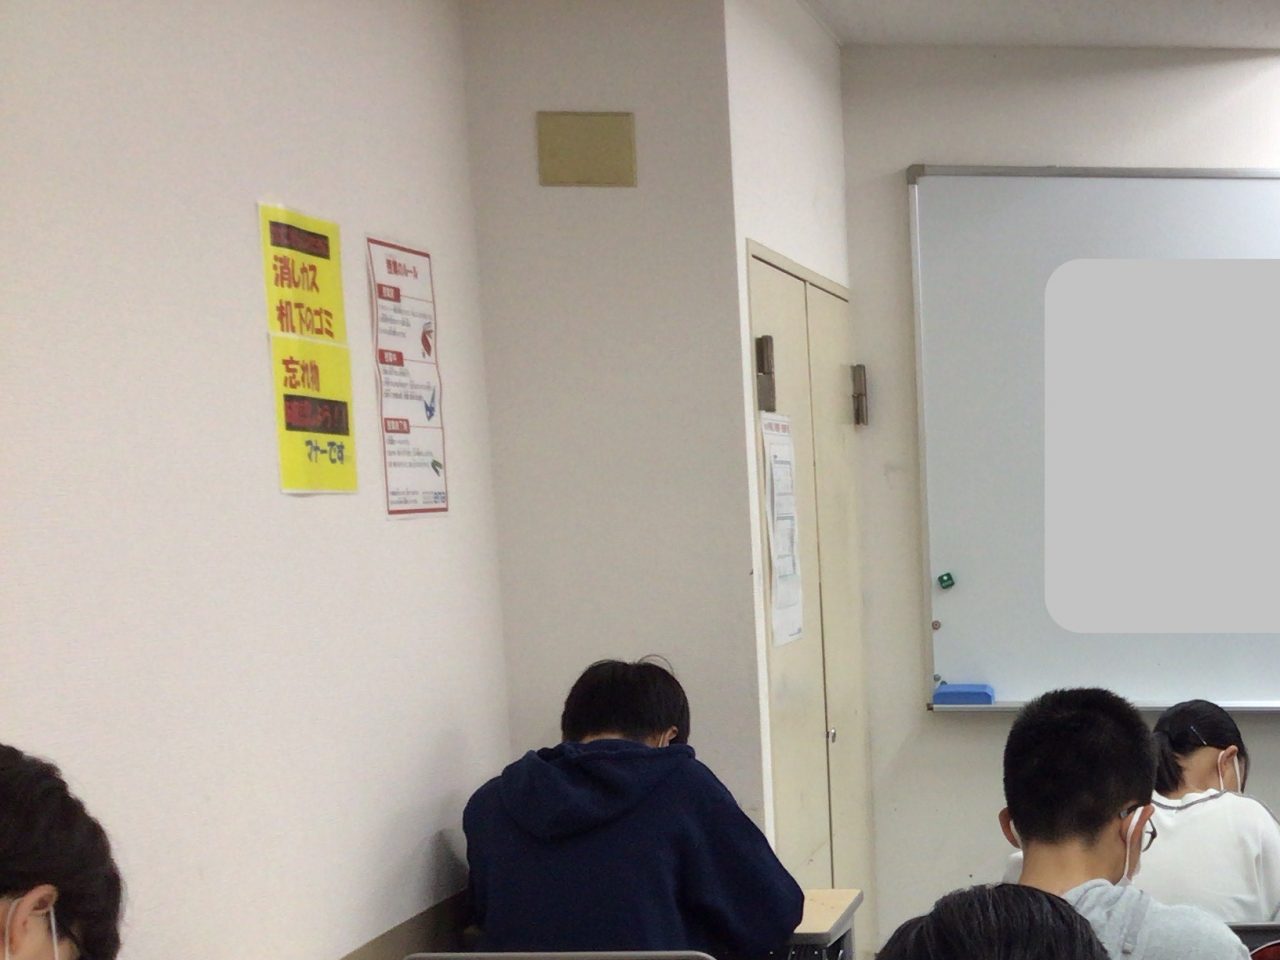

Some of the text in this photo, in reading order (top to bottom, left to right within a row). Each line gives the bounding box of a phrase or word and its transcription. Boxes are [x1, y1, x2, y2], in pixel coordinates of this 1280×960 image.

[273, 254, 319, 293] 消しカス
[276, 299, 334, 339] 机下のゴミ
[282, 355, 321, 392] 忘れ物
